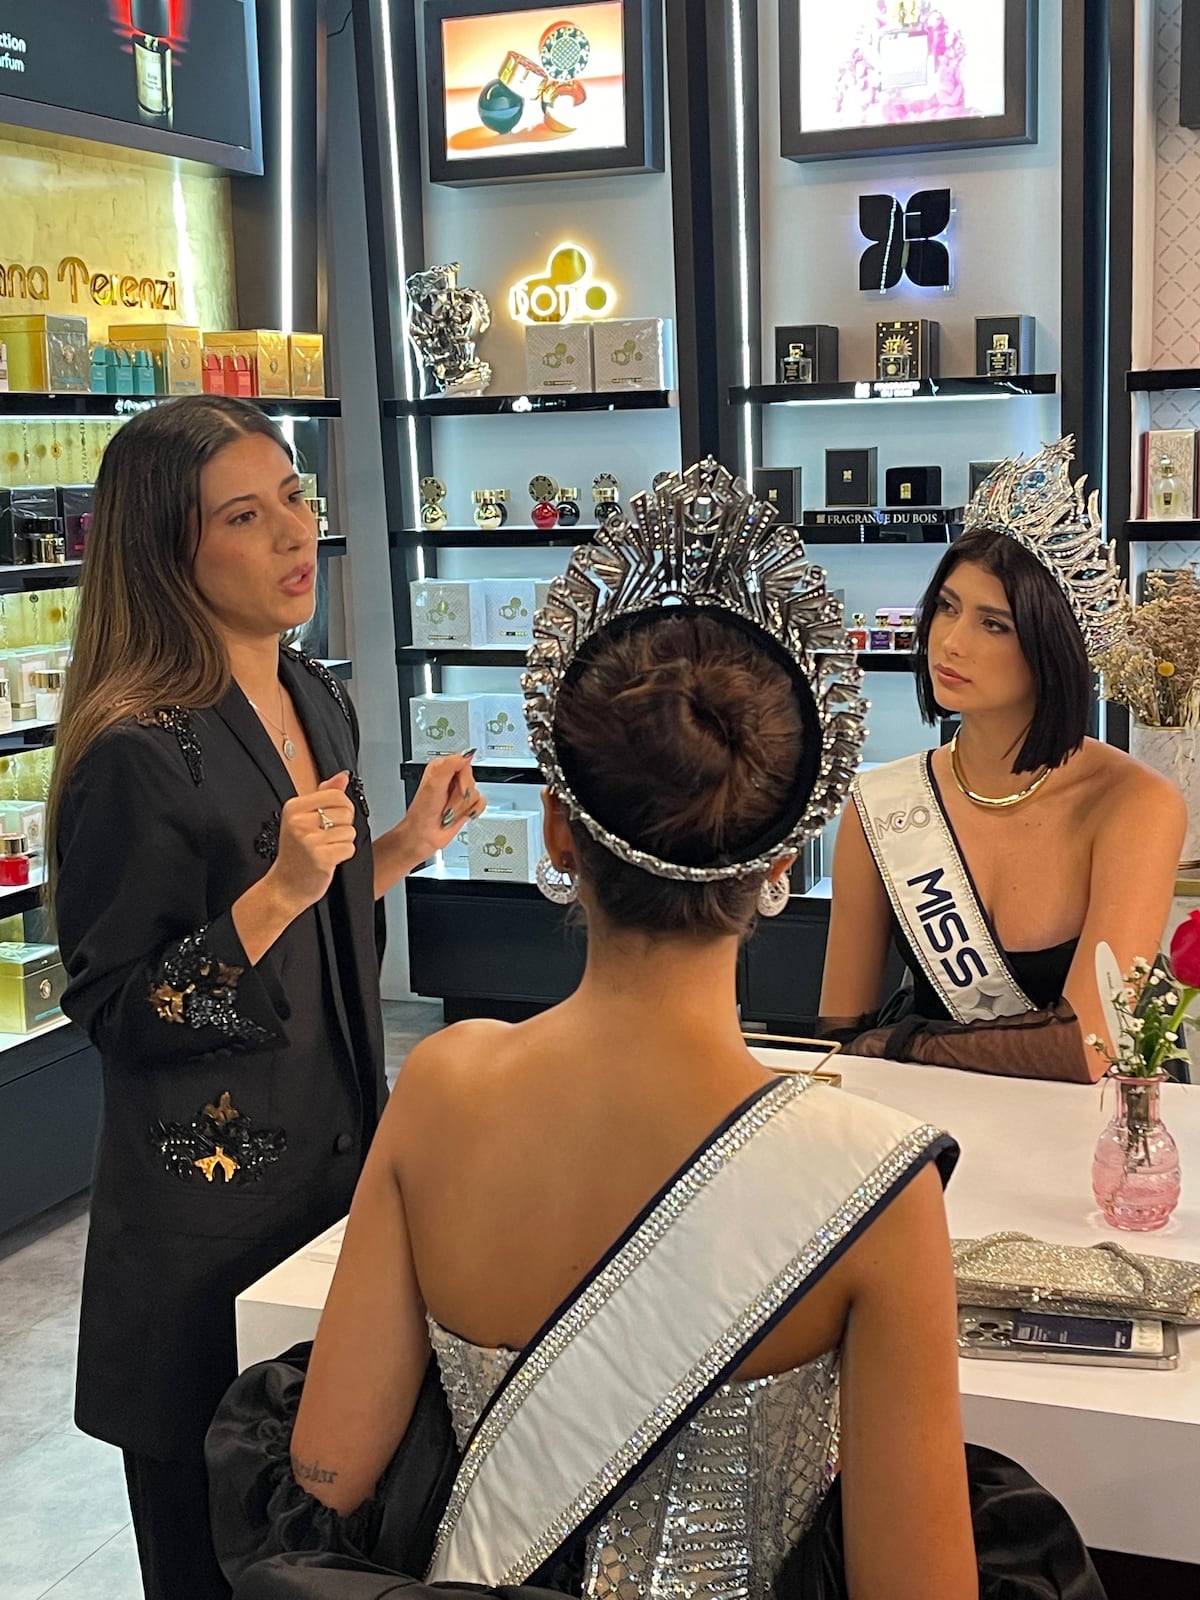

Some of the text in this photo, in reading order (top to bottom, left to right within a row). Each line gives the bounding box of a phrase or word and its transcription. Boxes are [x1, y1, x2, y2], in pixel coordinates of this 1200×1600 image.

[57, 256, 177, 310] Terenzi
[827, 513, 938, 525] FRAGRANCE DU BOIS
[907, 867, 989, 987] MISS
